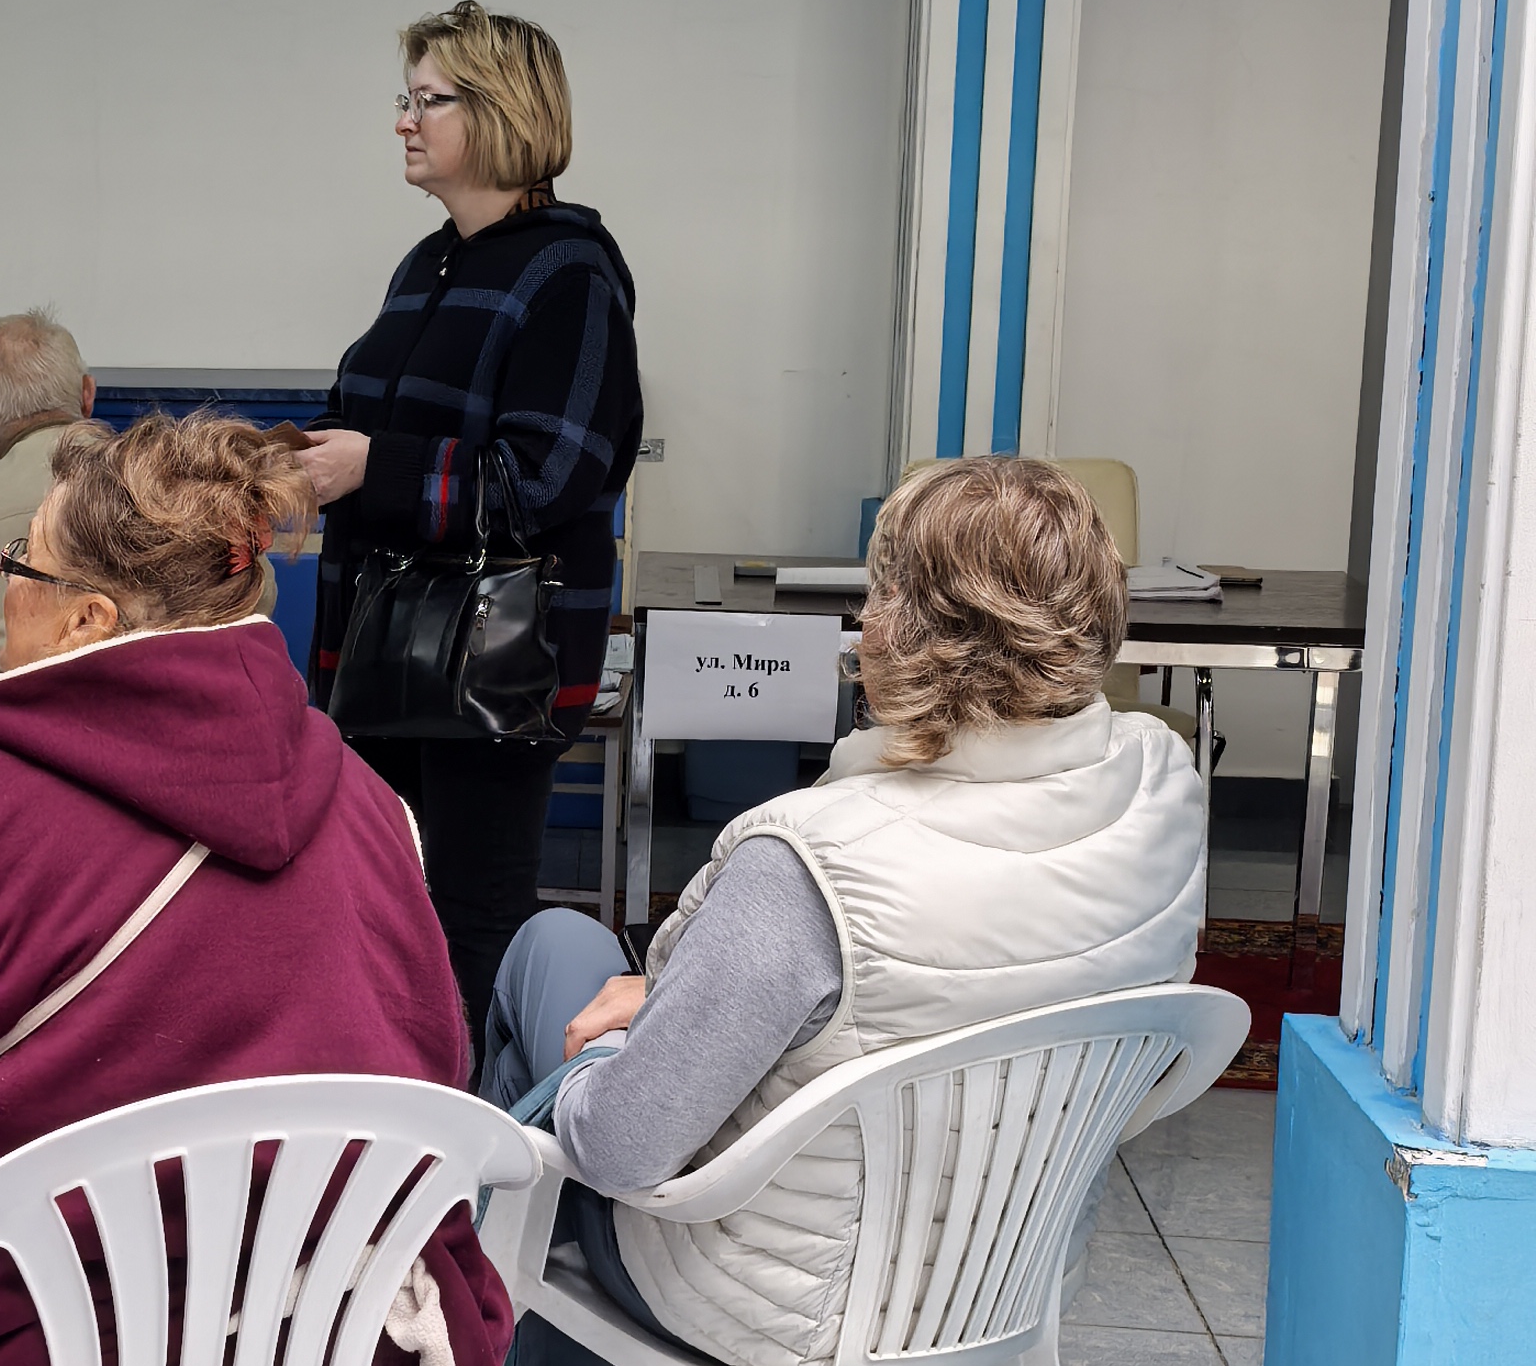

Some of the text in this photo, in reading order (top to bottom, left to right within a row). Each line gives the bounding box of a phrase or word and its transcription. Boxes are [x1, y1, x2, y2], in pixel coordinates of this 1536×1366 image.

[695, 654, 791, 675] ул. Мира
[723, 681, 759, 699] д. 6
